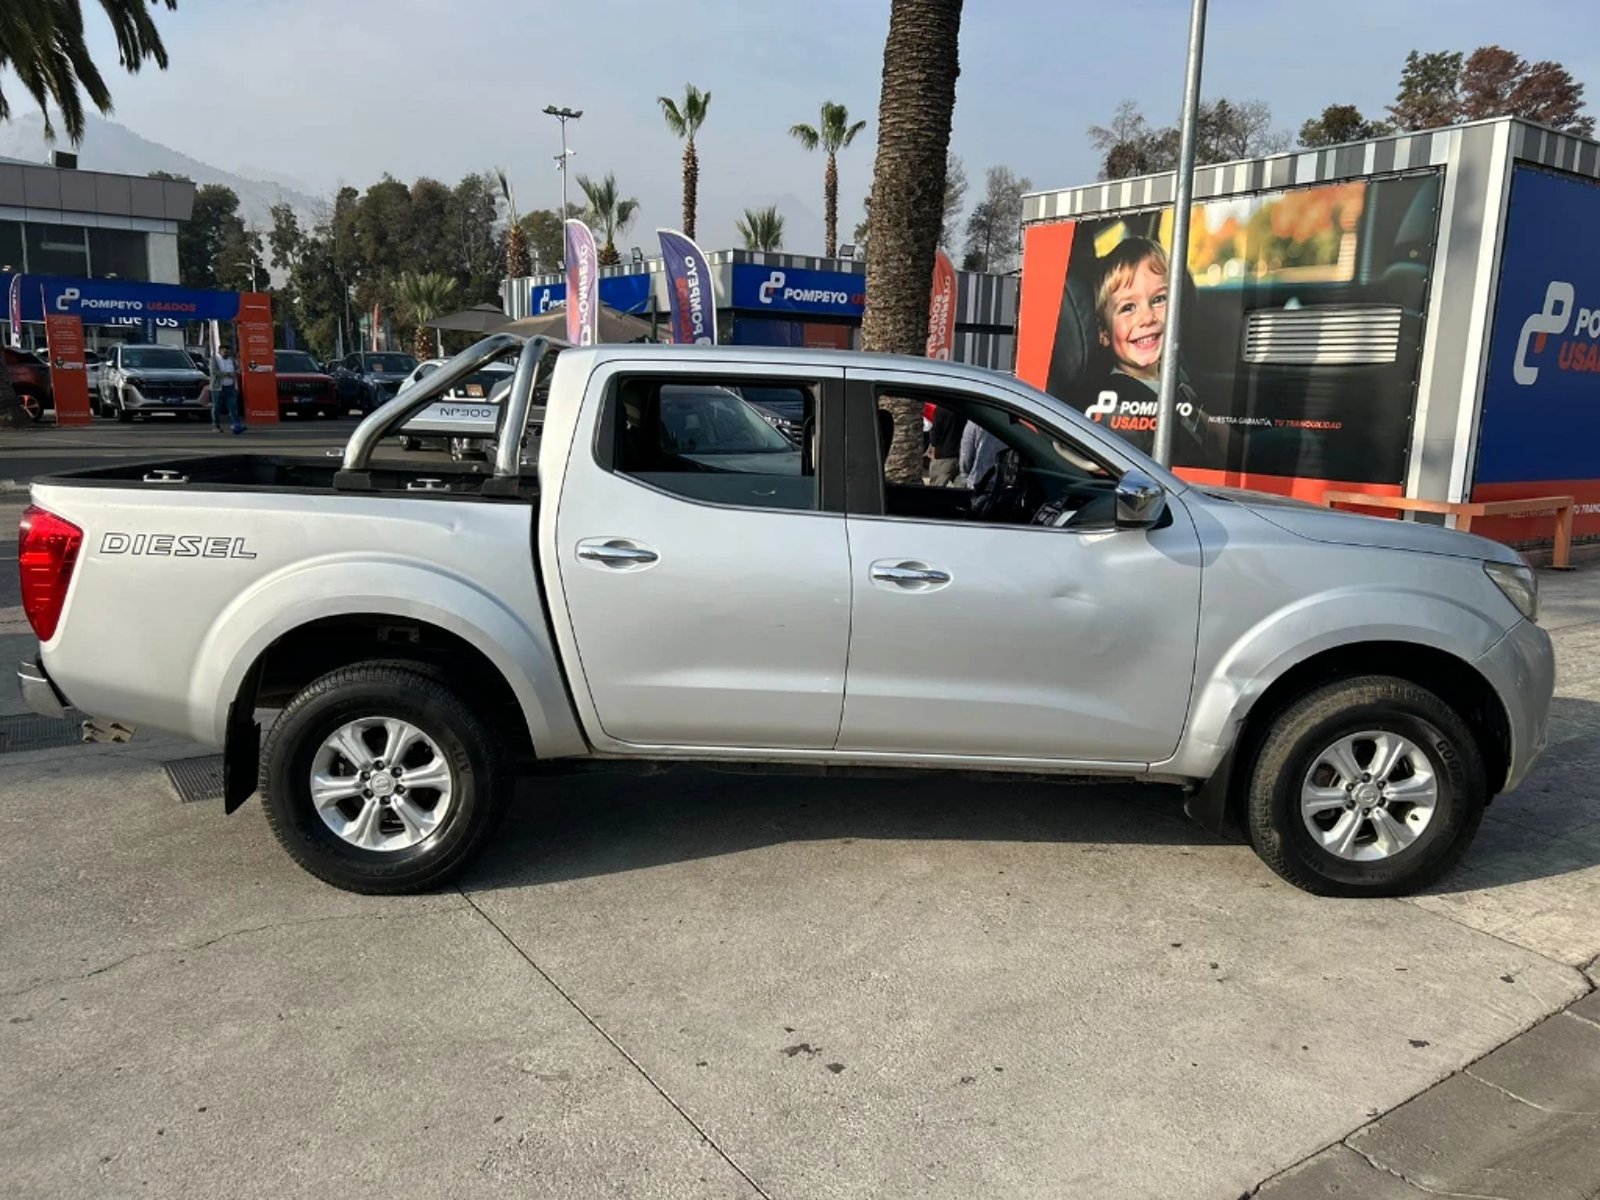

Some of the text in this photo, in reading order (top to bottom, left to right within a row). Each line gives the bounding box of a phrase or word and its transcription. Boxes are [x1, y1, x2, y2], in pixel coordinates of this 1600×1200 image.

[80, 298, 196, 312] POMPEYO USADOS
[784, 287, 848, 305] POMPEYO
[1558, 340, 1600, 373] USA
[1208, 414, 1237, 425] NUESTRA
[1275, 419, 1284, 428] TU
[1286, 419, 1343, 430] TRANQUILIDAD
[100, 532, 257, 559] DIESEL
